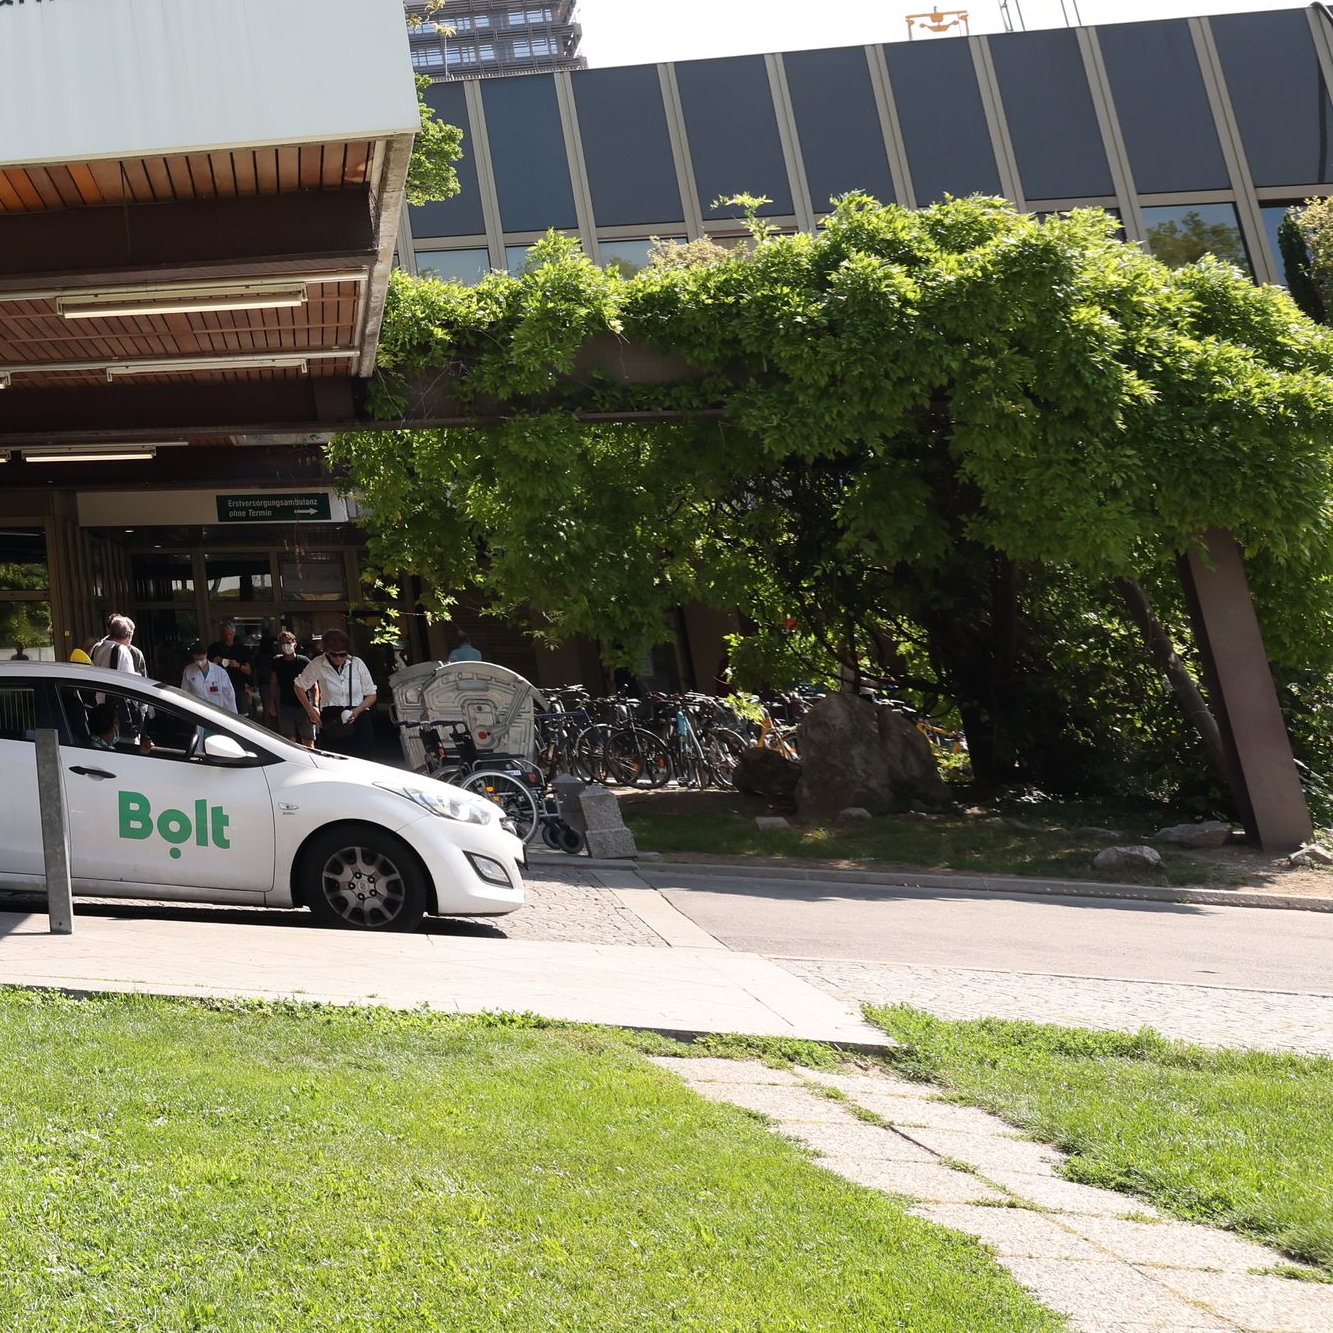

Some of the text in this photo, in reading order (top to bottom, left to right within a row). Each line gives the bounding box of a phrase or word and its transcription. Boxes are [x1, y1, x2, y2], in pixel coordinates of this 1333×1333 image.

[228, 498, 318, 507] Erstversorgungsambulanz
[228, 509, 272, 517] ohne Termin
[118, 790, 231, 859] Bolt
